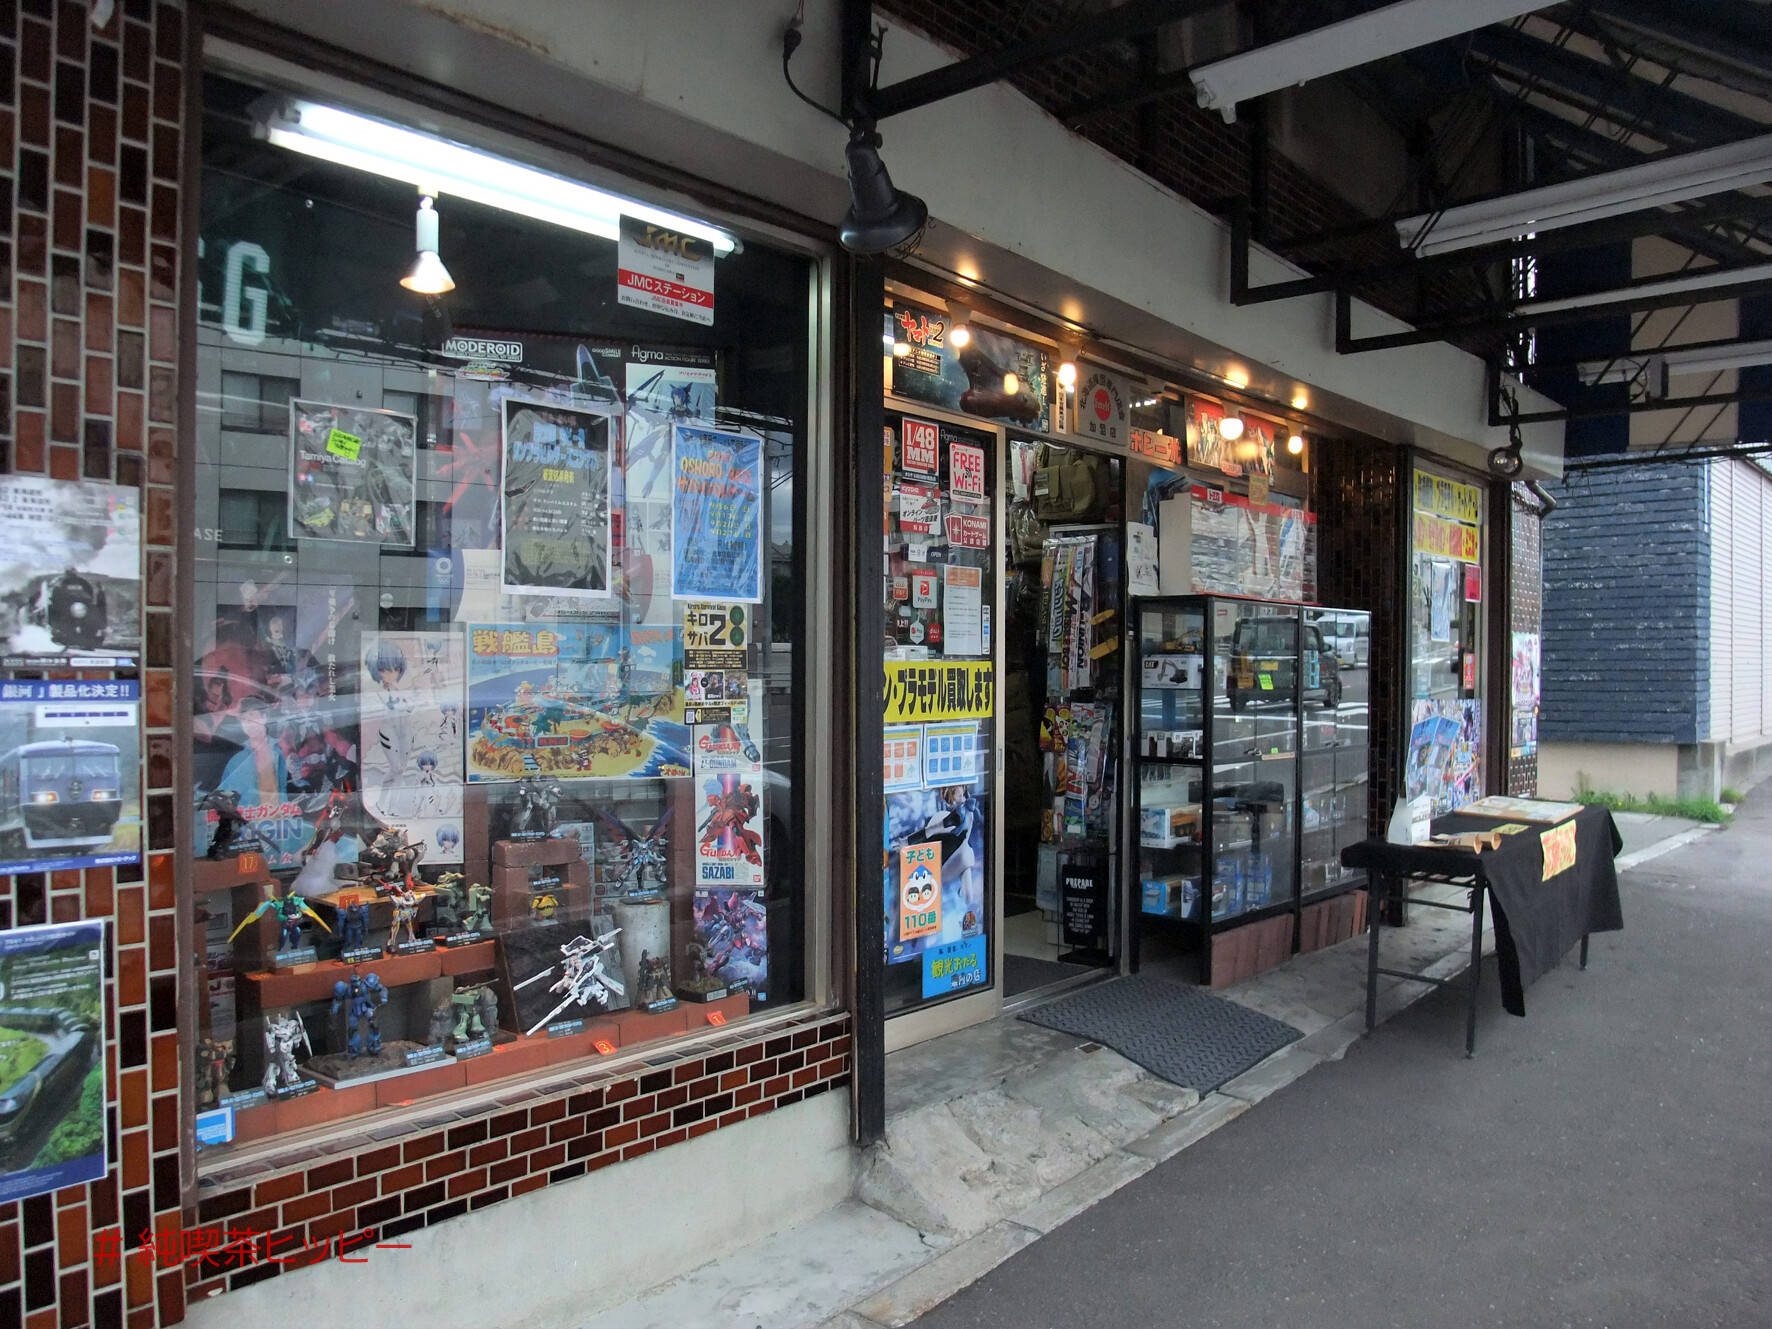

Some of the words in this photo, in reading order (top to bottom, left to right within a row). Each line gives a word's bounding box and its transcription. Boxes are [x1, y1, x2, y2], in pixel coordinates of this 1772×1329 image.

[627, 273, 706, 303] JMCステーション
[446, 340, 520, 356] MODEROID
[631, 344, 664, 362] figma
[906, 424, 935, 450] 1/48
[1089, 421, 1117, 438] 加盟店
[300, 450, 332, 463] Tamiya
[906, 446, 935, 464] MM
[953, 452, 981, 473] FREE
[953, 471, 981, 492] Wi-Fi
[963, 519, 987, 530] KONAMI
[963, 530, 987, 538] カードゲーム
[687, 611, 708, 626] キロ
[472, 629, 560, 656] 戦艦島
[687, 631, 709, 646] サバ
[243, 856, 254, 870] 17
[905, 848, 935, 864] 子ども
[702, 866, 734, 880] SAZABI
[904, 911, 937, 930] 110番
[931, 953, 978, 979] 観光おたる
[598, 1043, 610, 1053] 3
